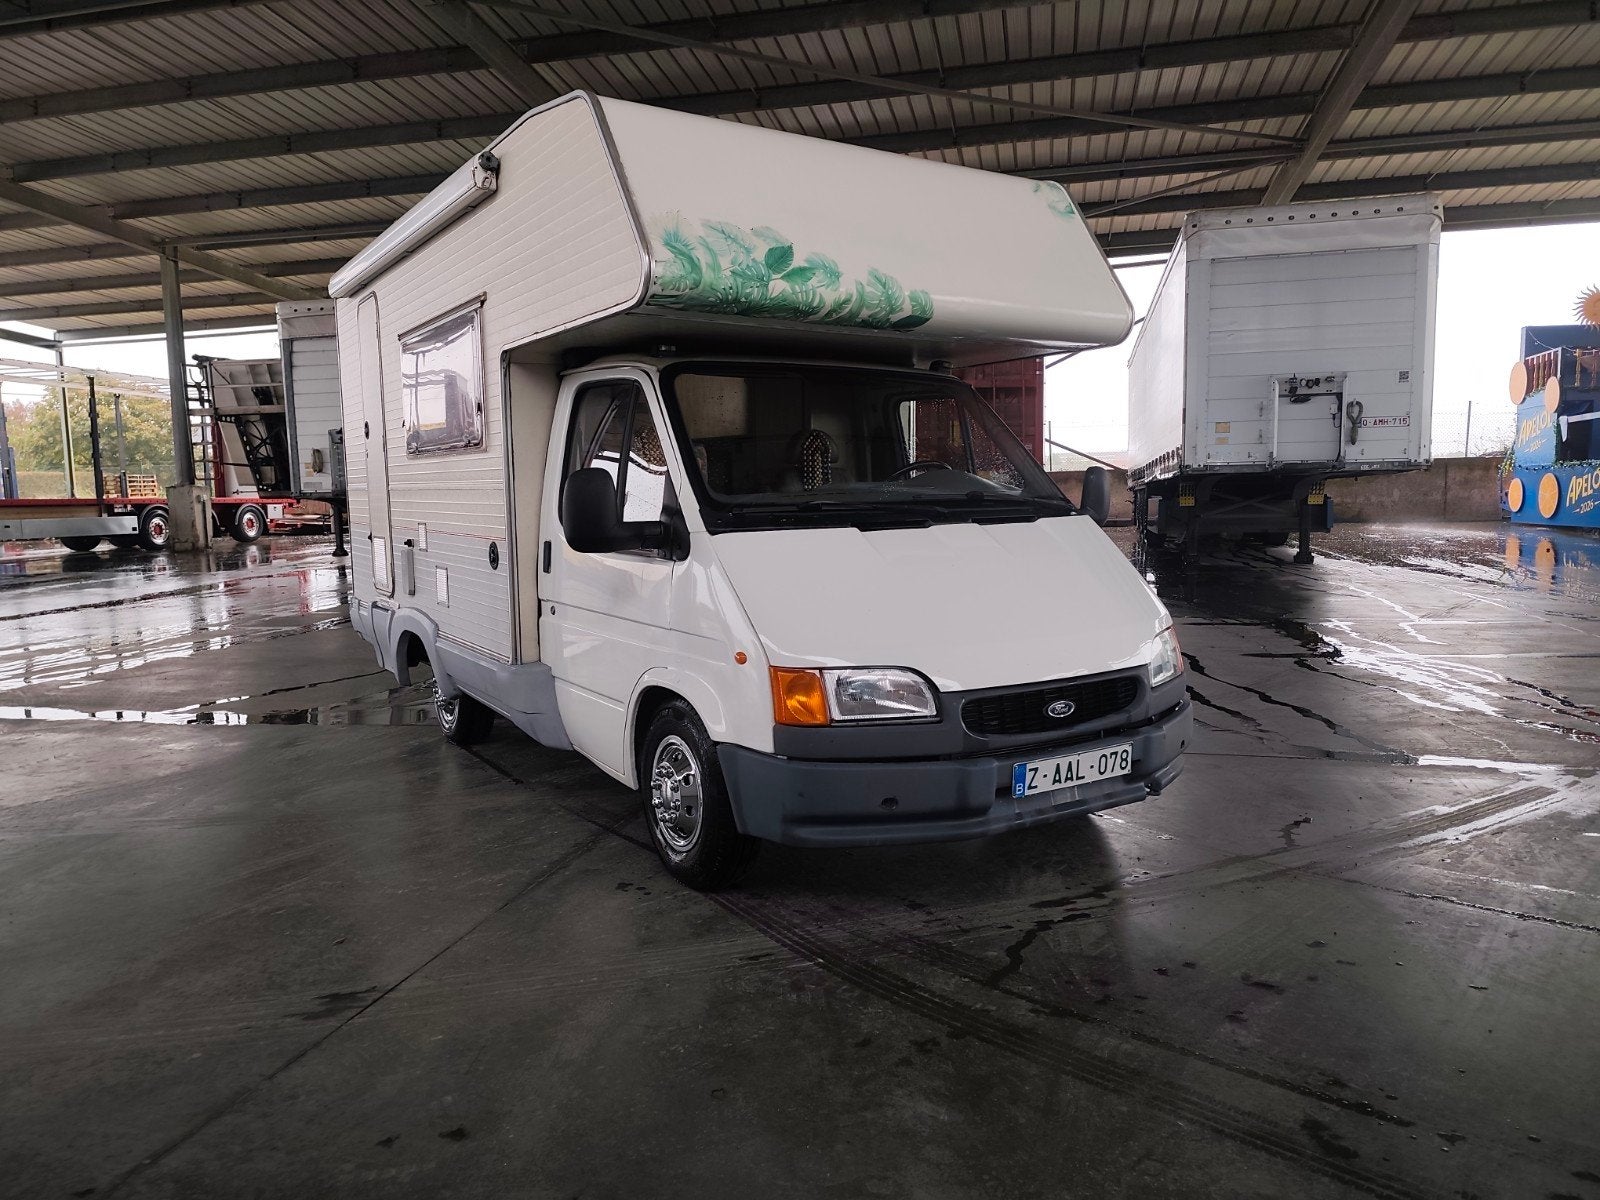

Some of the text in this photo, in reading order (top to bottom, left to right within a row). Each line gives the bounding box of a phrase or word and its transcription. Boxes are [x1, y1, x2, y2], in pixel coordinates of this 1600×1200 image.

[1580, 499, 1594, 513] 2026
[1015, 749, 1129, 795] B Z-AAL-078
